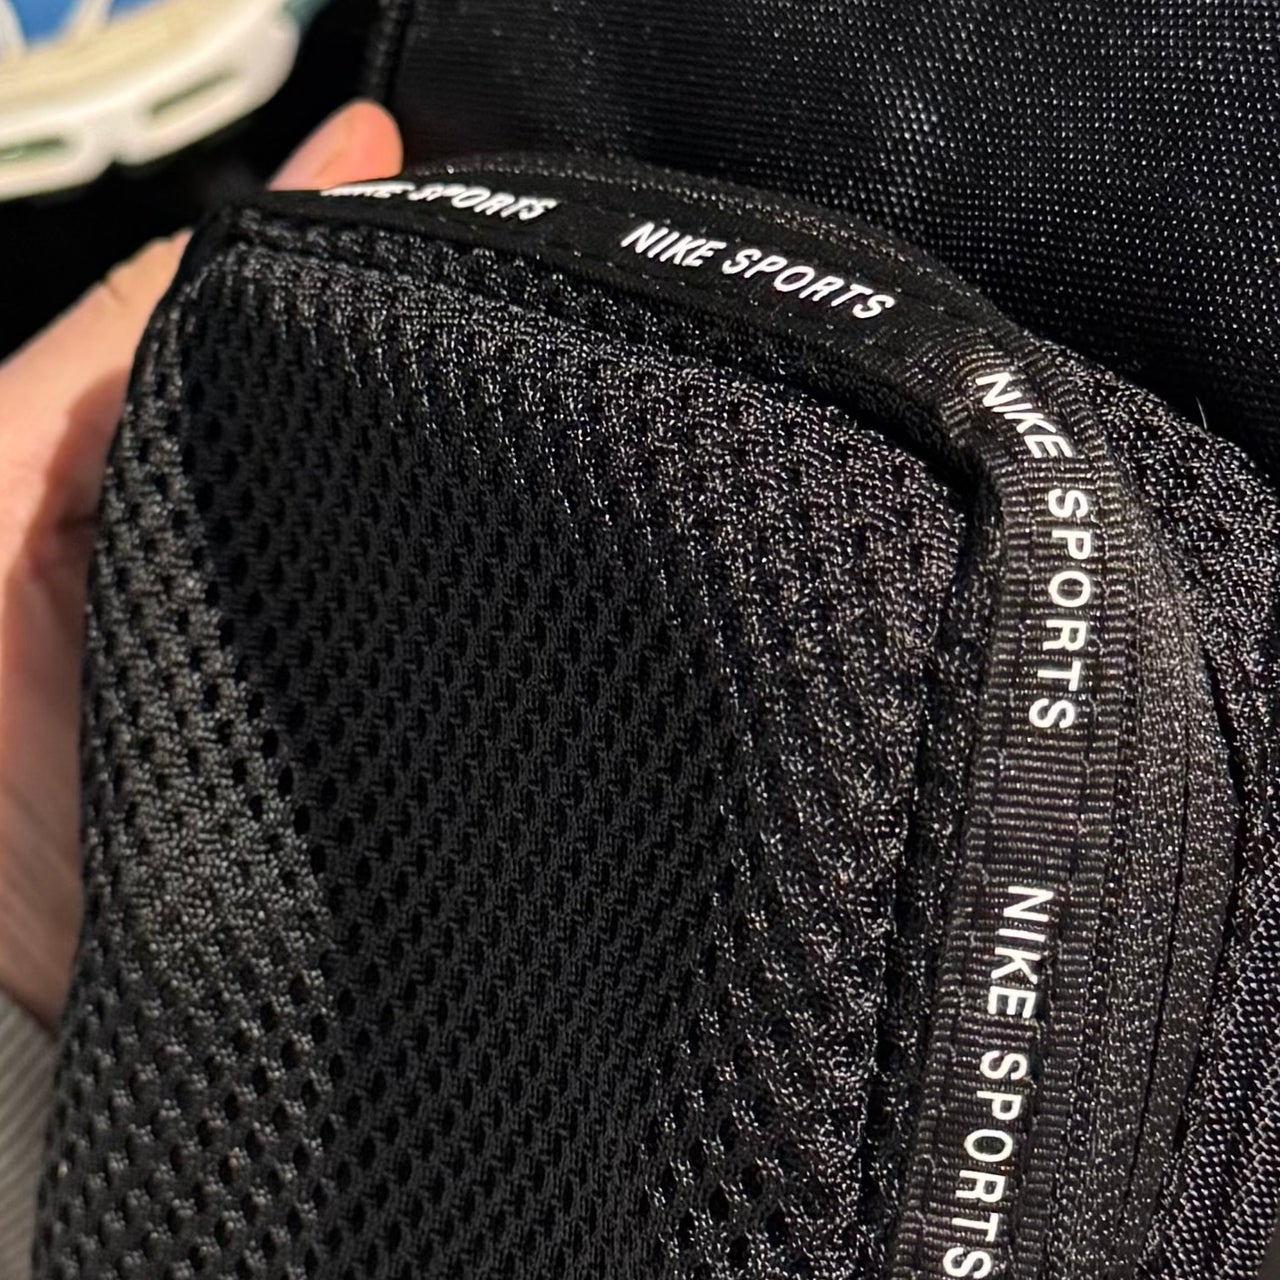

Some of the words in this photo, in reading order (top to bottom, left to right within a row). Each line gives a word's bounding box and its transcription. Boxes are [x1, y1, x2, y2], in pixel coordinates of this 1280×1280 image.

[407, 183, 558, 221] SPORTS
[620, 221, 726, 269] NIKE
[720, 247, 897, 320] SPORTS
[974, 371, 1074, 460] NIKE
[1027, 486, 1093, 730] SPORTS
[985, 884, 1056, 1020] NIKE
[941, 1049, 1029, 1280] SPORTS
